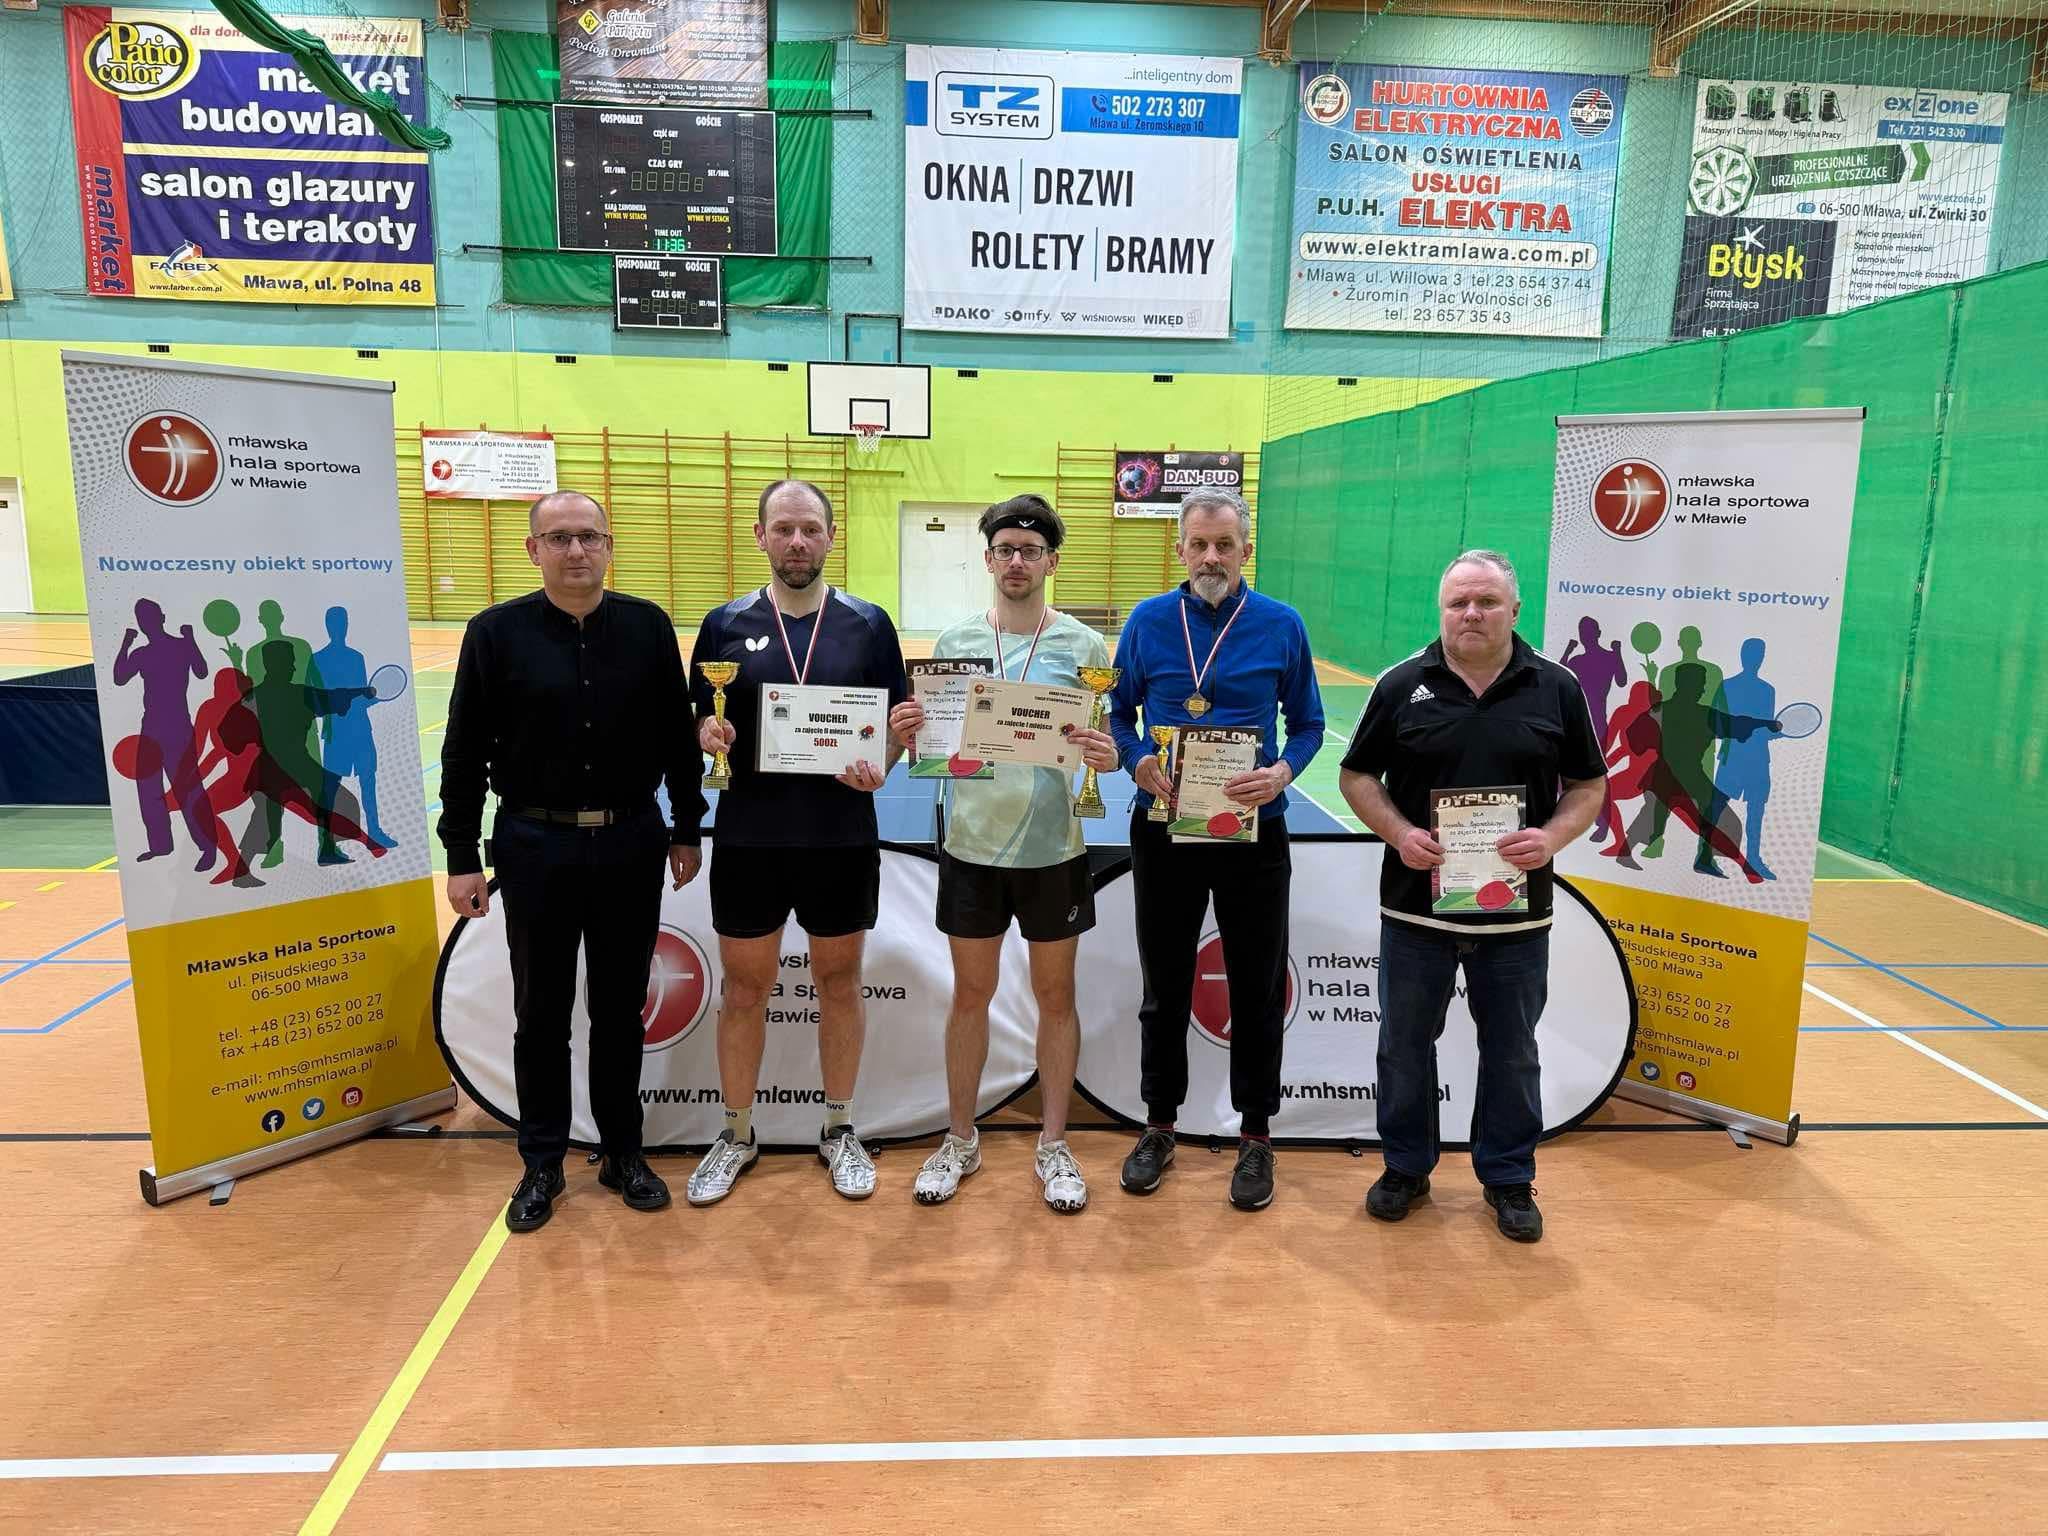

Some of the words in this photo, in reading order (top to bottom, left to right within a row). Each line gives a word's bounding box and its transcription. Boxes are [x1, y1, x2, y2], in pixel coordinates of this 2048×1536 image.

[607, 8, 646, 24] Galeria
[190, 25, 210, 36] dla
[108, 22, 184, 67] Patio
[569, 37, 609, 57] Podłogi
[97, 62, 162, 86] color
[258, 62, 411, 96] maket
[1205, 71, 1233, 84] dom
[947, 83, 1040, 111] TZ
[1372, 80, 1549, 111] HURTOWNIA
[1112, 96, 1141, 116] 502
[1146, 97, 1172, 117] 273
[1178, 99, 1205, 118] 307
[1570, 109, 1612, 118] ELEKTRA
[181, 99, 413, 137] budowla
[600, 113, 643, 124] GOSPODARZE
[696, 114, 721, 127] GOŚCIE
[950, 112, 1040, 128] SYSTEM
[1090, 117, 1118, 130] Mława
[1120, 118, 1133, 130] ul.
[1194, 121, 1204, 132] 10
[1354, 109, 1563, 140] ELEKTRYCZNA
[1888, 124, 1905, 135] Tel.
[1907, 125, 1924, 136] 721
[1927, 126, 1945, 137] 542
[648, 159, 665, 167] CZAS
[668, 160, 683, 168] GRY
[1328, 143, 1408, 163] SALON
[1422, 143, 1583, 171] OŚWIETLENIA
[1793, 154, 1869, 171] PROFESJONALNE
[140, 168, 254, 199] salon
[268, 171, 415, 209] glazury
[924, 162, 1010, 203] OKNA
[1033, 168, 1134, 207] DRZWI
[1411, 172, 1501, 195] USŁUGI
[1771, 172, 1831, 188] URZĄDZENIA
[1317, 198, 1385, 216] P.U.H.
[1398, 197, 1573, 233] ELEKTRA
[1819, 202, 1860, 216] 06-500
[1909, 205, 1925, 219] ul.
[1929, 205, 1967, 221] Żwirki
[1970, 210, 1987, 222] 30
[95, 166, 126, 291] market
[218, 209, 230, 240] i
[244, 213, 418, 251] terakoty
[655, 239, 685, 251] 11:36
[971, 231, 1085, 271] ROLETY
[1106, 236, 1215, 275] BRAMY
[1306, 239, 1589, 266] www.elektramlawa.com.pl
[150, 261, 219, 272] FARBEX
[618, 259, 660, 270] GOSPODARZE
[685, 260, 711, 272] GOŚCIE
[1708, 244, 1805, 289] Błysk
[150, 284, 222, 292] www.farbex.com.pl
[243, 274, 309, 292] Mława,
[314, 275, 337, 291] ul.
[343, 277, 394, 292] Polna
[400, 278, 421, 293] 48
[1307, 269, 1355, 283] Mława
[1365, 270, 1383, 284] ul.
[1390, 271, 1448, 285] Willowa
[1453, 274, 1462, 285] 3
[1518, 276, 1547, 289] 654
[1551, 277, 1569, 290] 37
[1575, 278, 1592, 290] 44
[1345, 284, 1409, 302] Żuromin
[1422, 290, 1456, 305] Plac
[1461, 290, 1529, 307] Wolności
[1533, 294, 1552, 307] 36
[1706, 287, 1733, 298] Firma
[1704, 299, 1760, 311] Sprzątająca
[944, 307, 991, 320] DAKO
[1082, 313, 1135, 323] WIŚNIOWSKI
[1143, 314, 1184, 327] WIKĘD
[1385, 307, 1404, 320] tel.
[1413, 308, 1432, 321] 23
[1436, 309, 1465, 322] 657
[1470, 310, 1490, 323] 35
[1492, 311, 1512, 324] 43
[228, 434, 308, 452] mławska
[230, 454, 277, 470] hala
[284, 459, 361, 475] sportowa
[231, 478, 243, 487] w
[250, 476, 307, 490] Mławie
[1678, 475, 1755, 488] mławska
[1676, 494, 1720, 507] hala
[1727, 495, 1810, 509] sportowa
[1674, 515, 1686, 524] w
[1691, 513, 1747, 525] Mławie
[99, 556, 236, 575] Nowoczesny
[244, 556, 306, 571] obiekt
[312, 557, 393, 573] sportowy
[1558, 580, 1666, 601] Nowoczesny
[1672, 587, 1732, 602] obiekt
[1737, 590, 1830, 611] sportowy
[913, 662, 987, 676] DYPLOM
[1410, 693, 1435, 704] adidas
[809, 713, 848, 724] VOUCHER
[1011, 707, 1051, 719] VOUCHER
[1186, 730, 1257, 744] DYPLOM
[1439, 793, 1518, 808] DYPLOM
[187, 949, 269, 977] Mławska
[275, 940, 313, 958] Hala
[318, 923, 397, 950] Sportowa
[1640, 924, 1675, 941] Hala
[1680, 932, 1758, 960] Sportowa
[227, 976, 246, 990] ul.
[252, 956, 337, 985] Piłsudskiego
[341, 950, 367, 966] 33a
[1663, 963, 1703, 980] Mława
[1700, 955, 1723, 970] 33a
[252, 979, 301, 1001] 06-500
[306, 970, 349, 989] Mława
[1308, 979, 1370, 997] hala
[1666, 991, 1690, 1005] 652
[1695, 998, 1711, 1010] 00
[1715, 1002, 1732, 1015] 27
[218, 1028, 243, 1043] tel.
[249, 1018, 279, 1036] +48
[283, 1010, 312, 1029] (23)
[315, 1004, 341, 1020] 652
[345, 999, 362, 1013] 00
[366, 993, 383, 1007] 27
[1308, 1008, 1325, 1021] w
[1665, 1005, 1689, 1019] 652
[1693, 1012, 1709, 1024] 00
[1713, 1016, 1730, 1030] 28
[221, 1044, 245, 1060] fax
[250, 1035, 280, 1053] +48
[284, 1027, 313, 1046] (23)
[317, 1020, 342, 1037] 652
[347, 1014, 363, 1028] 00
[367, 1009, 384, 1022] 28
[211, 1073, 262, 1097] e-mail:
[267, 1037, 399, 1081] mhs@mhsmlawa.pl
[244, 1059, 373, 1104] www.mhsmlawa.pl
